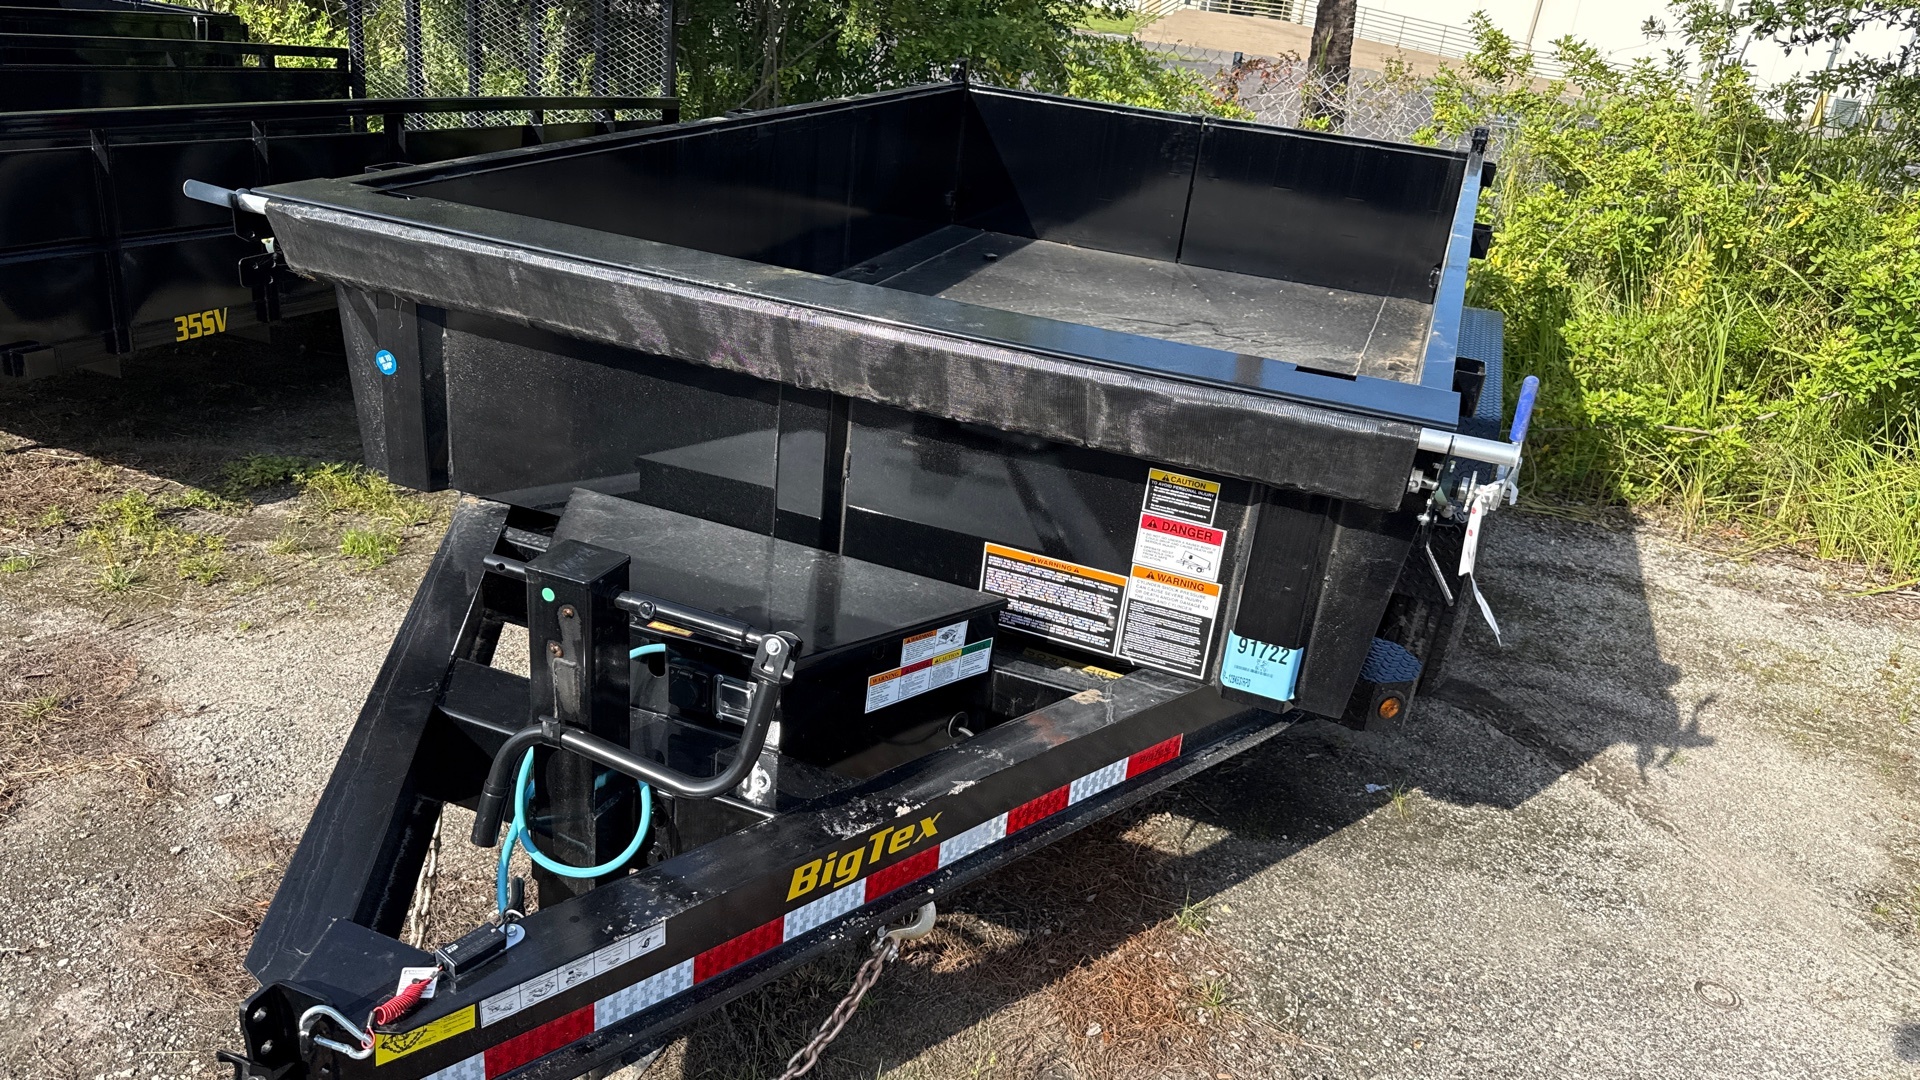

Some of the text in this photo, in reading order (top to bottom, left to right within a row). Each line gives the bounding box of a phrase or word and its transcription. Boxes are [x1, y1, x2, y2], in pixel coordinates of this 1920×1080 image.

[174, 307, 228, 342] 35SV
[1170, 475, 1207, 489] CAUTION
[1173, 485, 1197, 495] PERSONAL
[1198, 491, 1215, 499] INJURY
[1161, 521, 1213, 542] DANGER
[1037, 558, 1072, 571] WARNING
[1136, 578, 1160, 588] CYLINDER
[1179, 589, 1206, 600] PRESSURE
[1156, 572, 1205, 592] WARNING
[1143, 590, 1159, 598] DEATH
[1179, 600, 1200, 608] DAMAGE
[1147, 586, 1163, 594] CAUSE
[1164, 591, 1183, 599] SEVERE
[1184, 596, 1202, 604] INJURY
[1167, 602, 1191, 611] CYLINDER
[1238, 638, 1290, 665] 91722
[872, 672, 899, 683] WARNING
